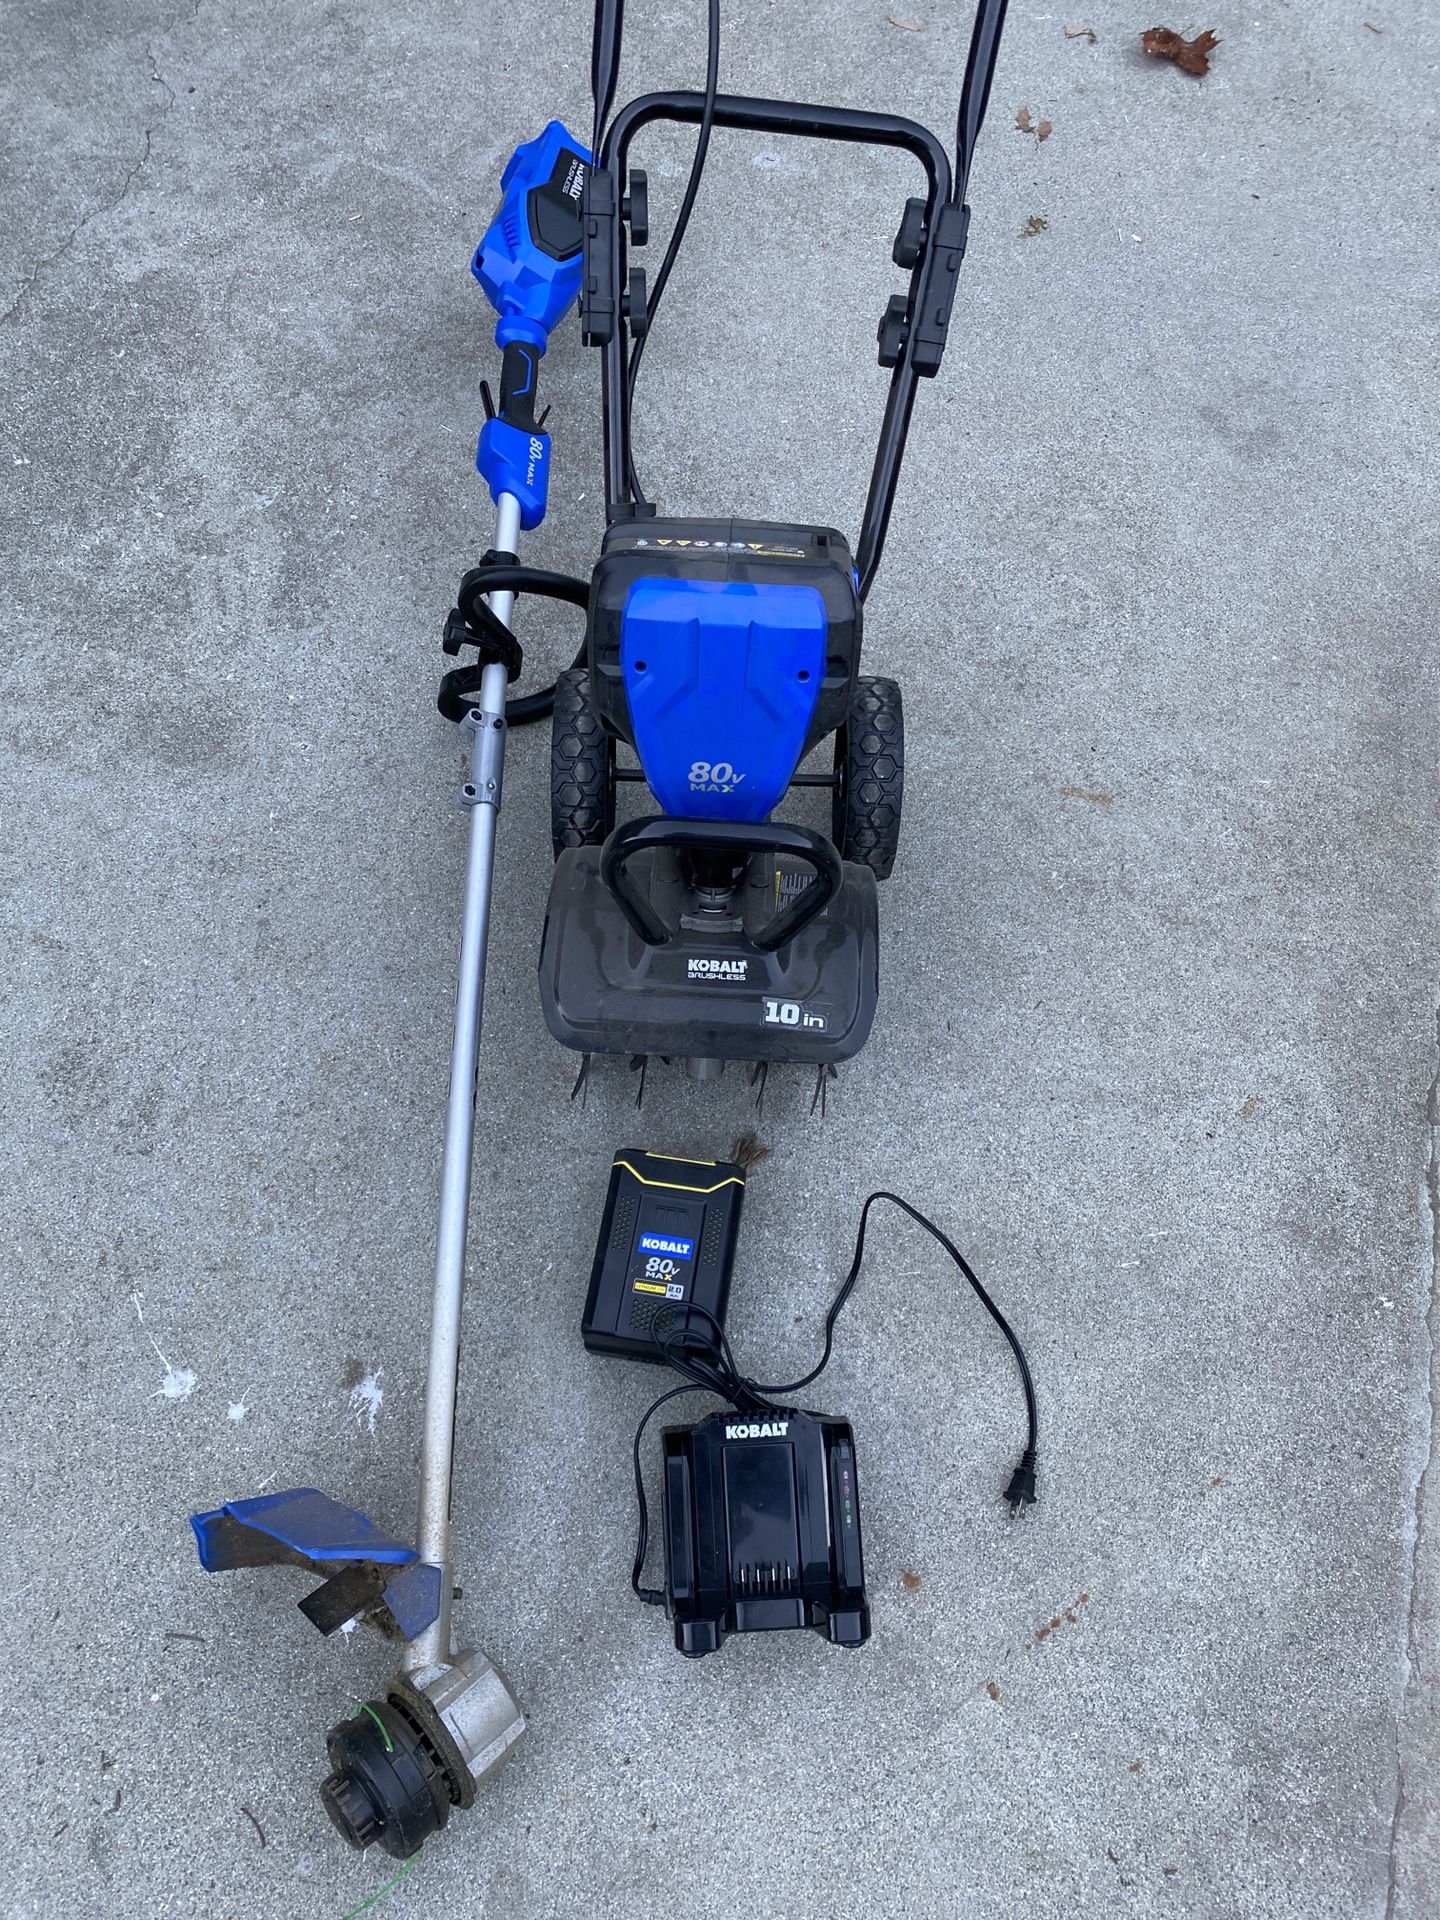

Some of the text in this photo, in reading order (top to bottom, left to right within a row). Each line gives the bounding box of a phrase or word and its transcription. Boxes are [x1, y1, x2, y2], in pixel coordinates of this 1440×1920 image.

[527, 462, 535, 486] MAX
[690, 783, 735, 793] MAX
[688, 959, 748, 973] KOBALT
[688, 972, 746, 981] BRUSHLESS
[765, 1001, 824, 1028] 10 in
[642, 1237, 690, 1254] KOBALT
[645, 1271, 672, 1281] MAX
[668, 1285, 682, 1293] 2.0
[725, 1422, 788, 1439] KOBALT
